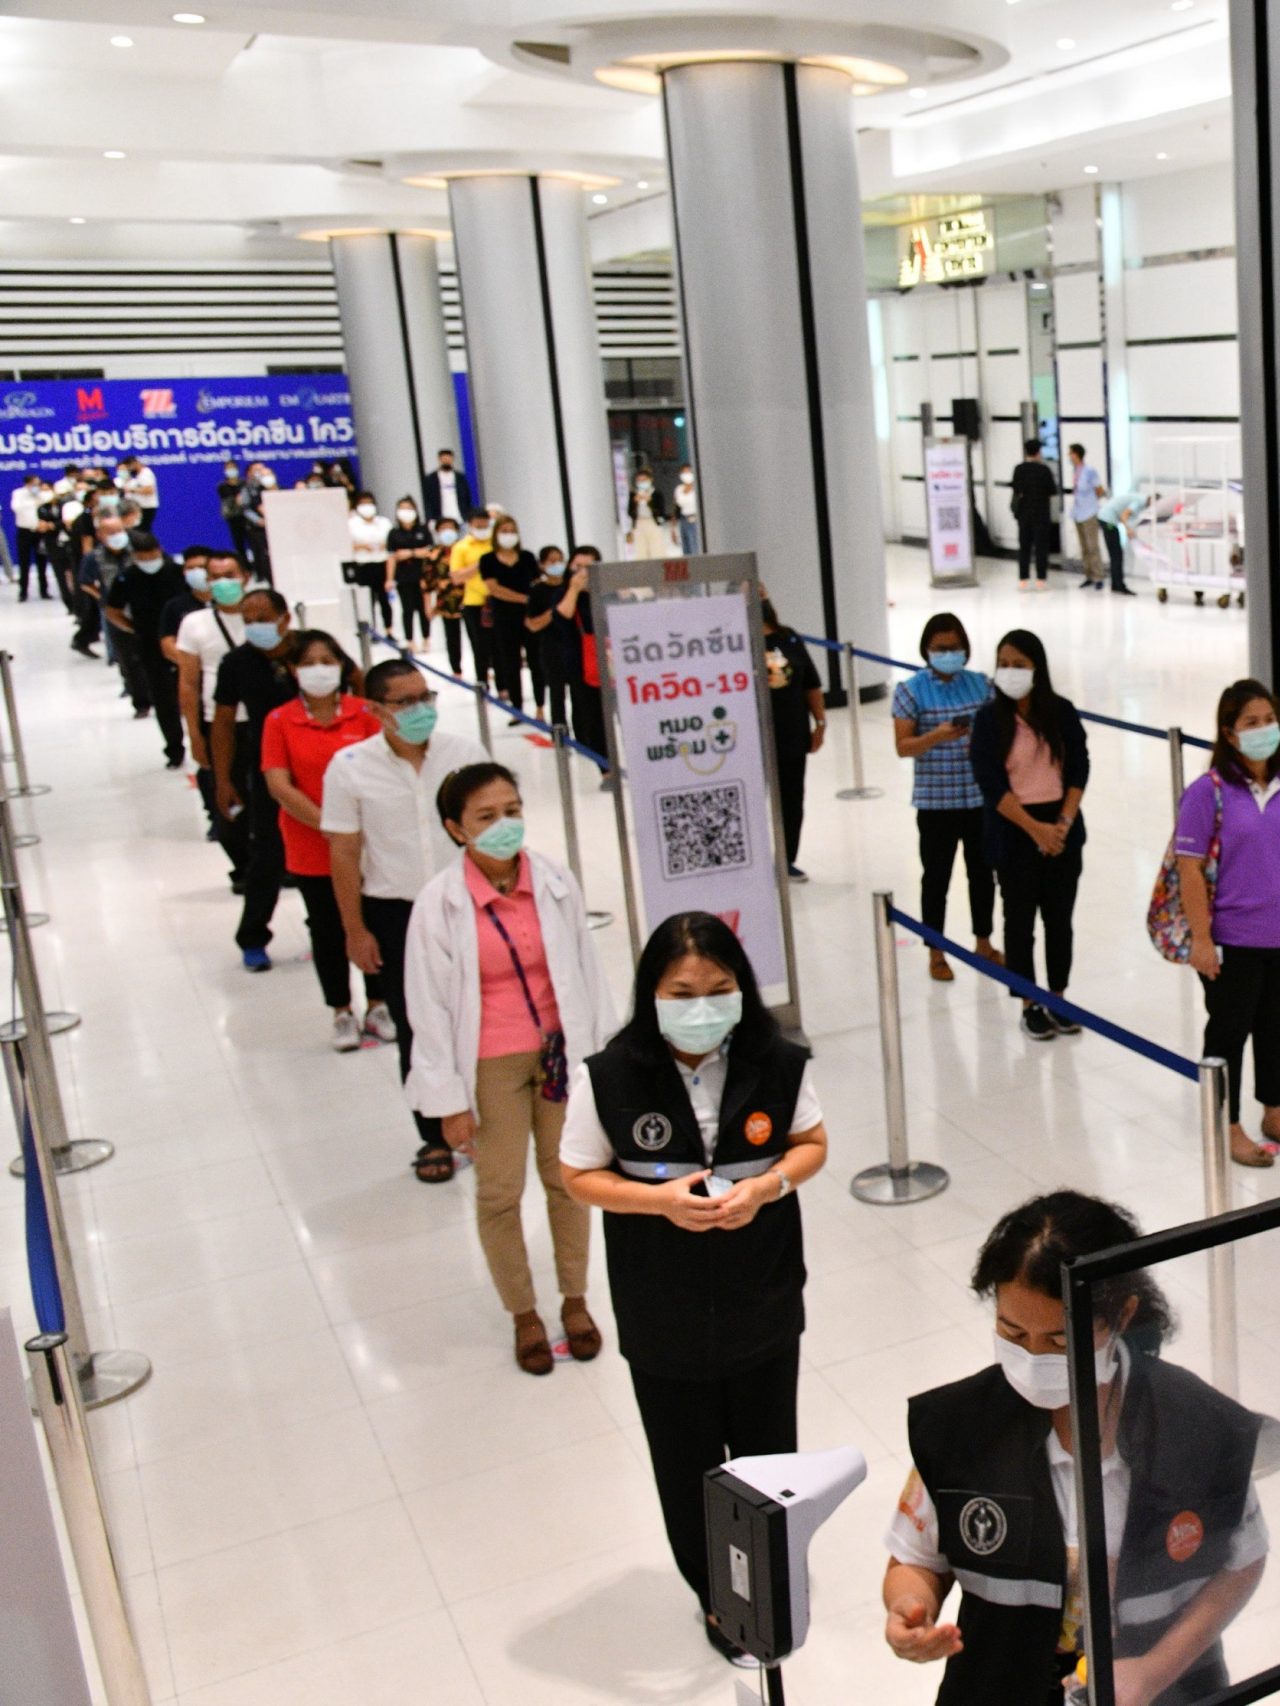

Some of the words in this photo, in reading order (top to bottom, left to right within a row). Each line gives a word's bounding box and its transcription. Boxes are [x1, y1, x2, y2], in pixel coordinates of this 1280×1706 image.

[621, 627, 744, 664] ฉีดวัคซีน
[626, 671, 748, 705] โควิด-19
[659, 715, 703, 736] หมอ
